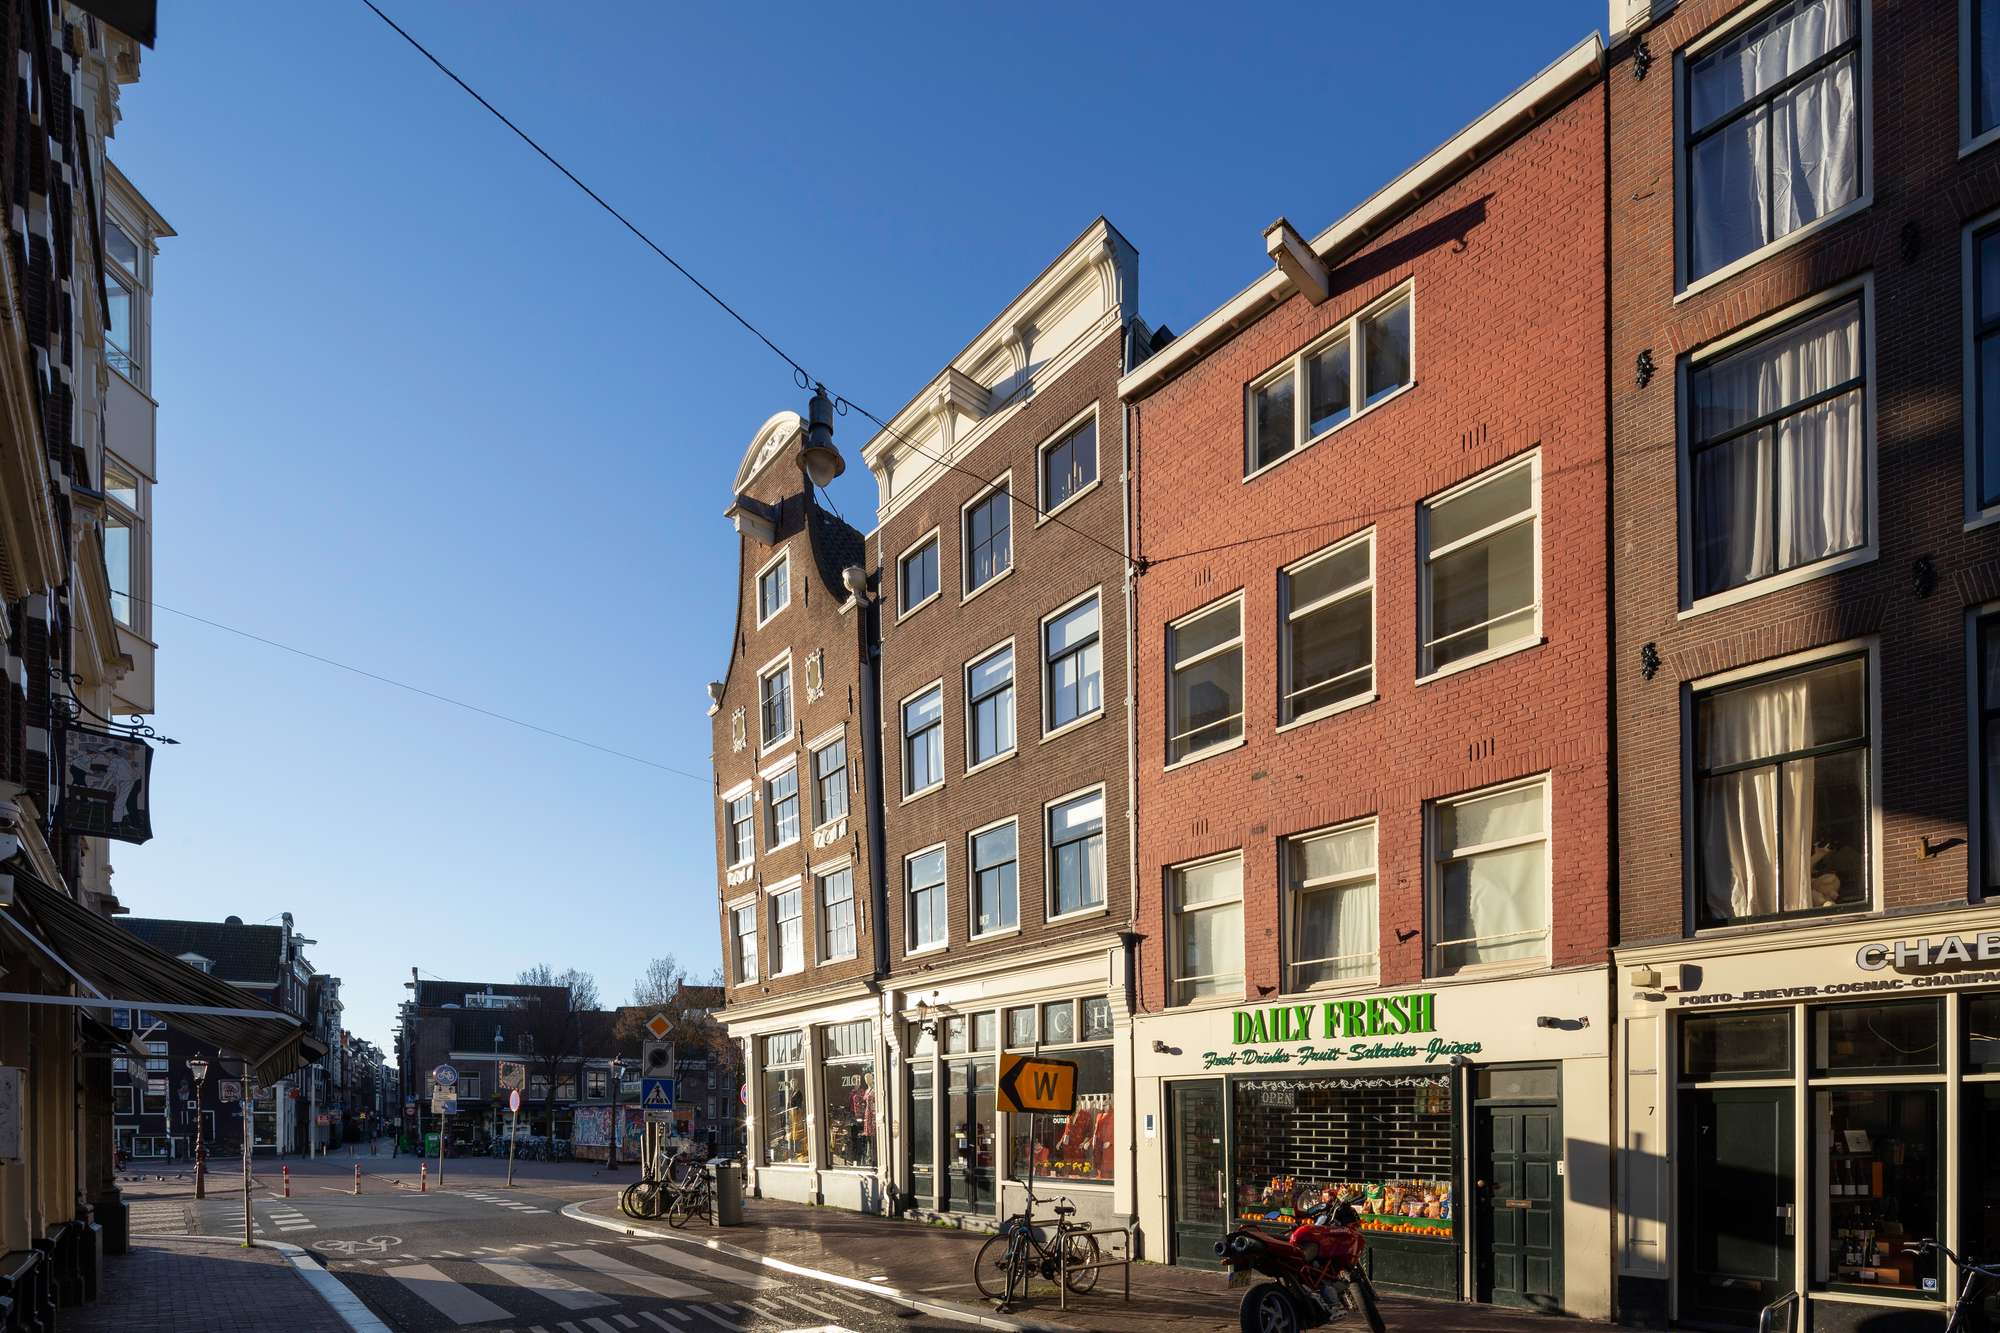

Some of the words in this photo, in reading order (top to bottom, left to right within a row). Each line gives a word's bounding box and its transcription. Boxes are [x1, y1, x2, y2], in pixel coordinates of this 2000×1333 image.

[1232, 1004, 1316, 1044] DAILY
[1323, 992, 1437, 1040] FRESH
[841, 1075, 861, 1087] ZILCH
[1034, 1071, 1059, 1101] W
[1262, 1092, 1292, 1104] OPEN
[1648, 1106, 1655, 1116] 7
[1701, 1125, 1710, 1135] 7
